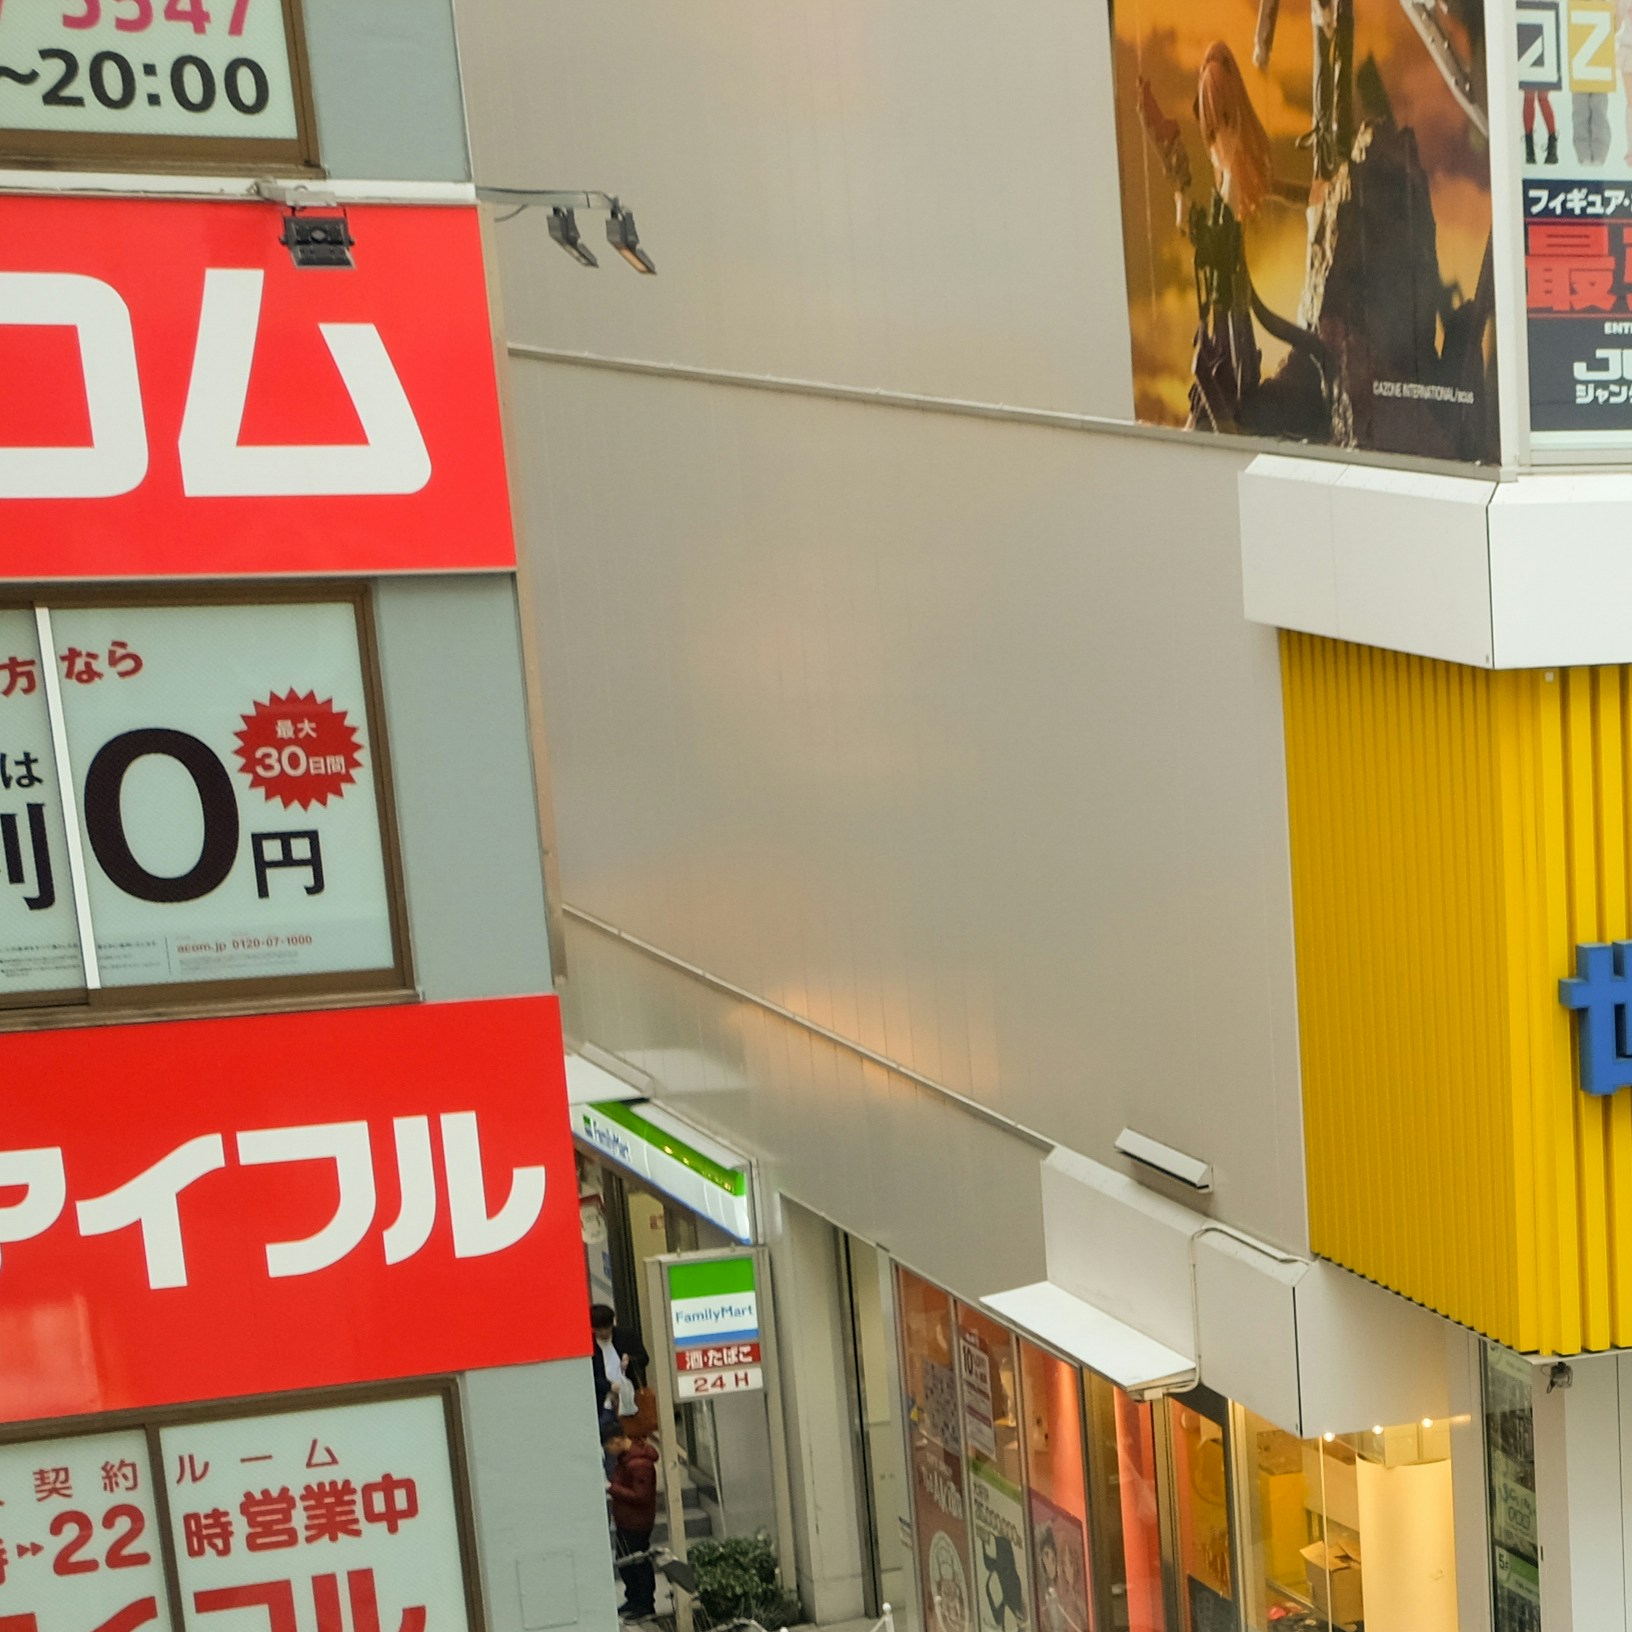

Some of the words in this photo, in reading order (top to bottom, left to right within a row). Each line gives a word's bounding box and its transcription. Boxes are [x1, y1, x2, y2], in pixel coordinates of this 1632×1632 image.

[275, 718, 318, 740] 最大
[254, 743, 347, 779] 30日間
[592, 1119, 632, 1162] FamilyMart
[675, 1303, 754, 1325] FamilyMart
[693, 1371, 727, 1393] 24
[734, 1372, 749, 1389] H
[34, 1438, 340, 1502] 契約ルーム
